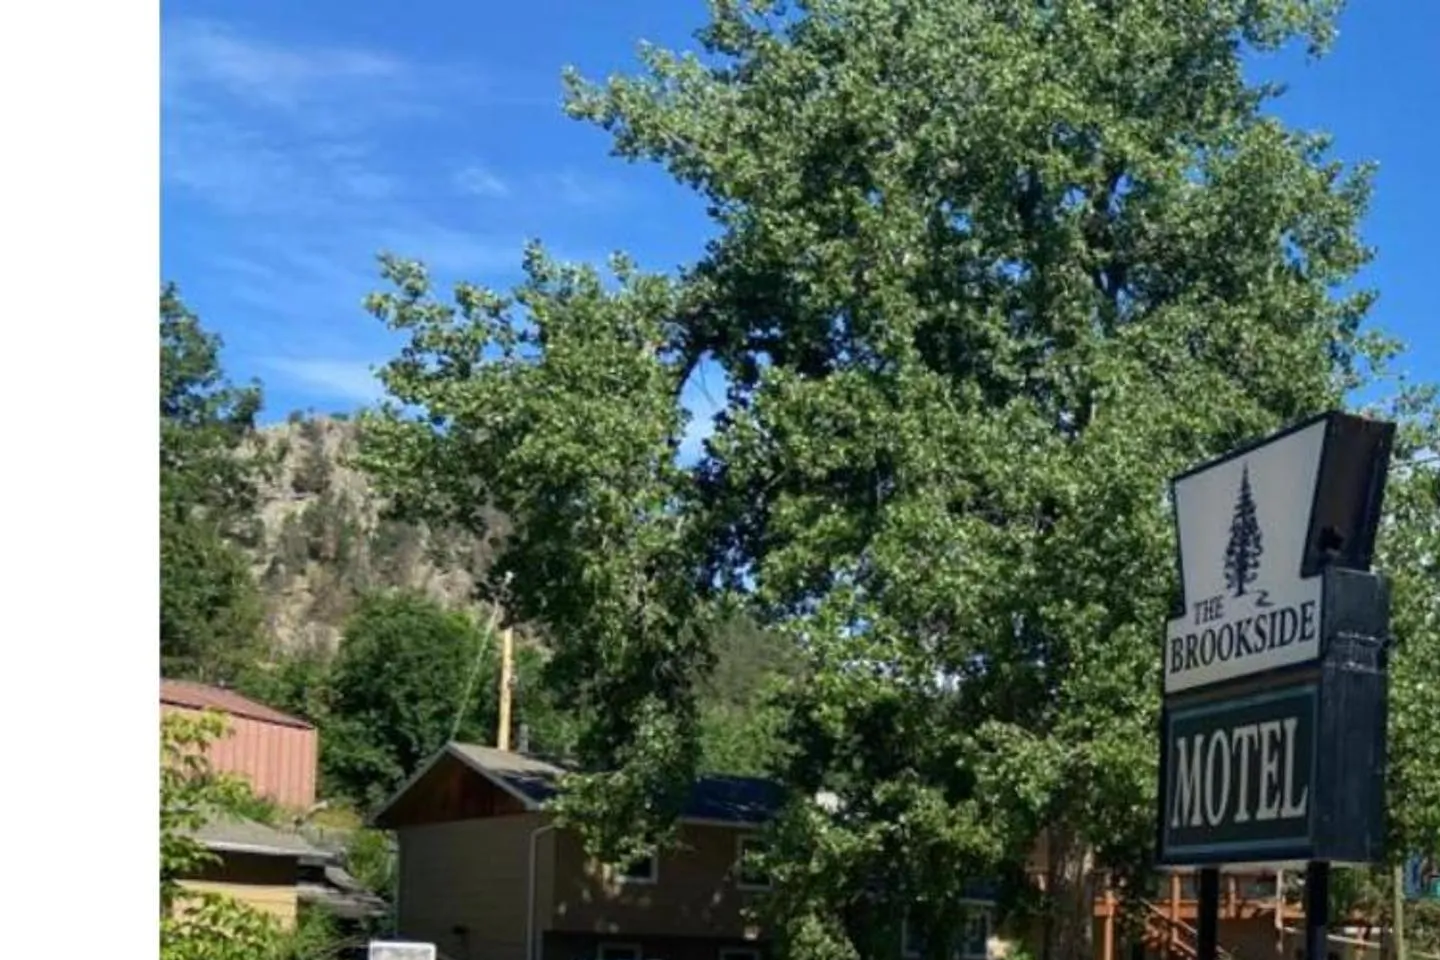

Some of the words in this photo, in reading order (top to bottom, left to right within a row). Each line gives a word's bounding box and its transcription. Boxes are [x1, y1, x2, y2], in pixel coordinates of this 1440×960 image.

[1169, 601, 1315, 674] BROOKSIDE
[1194, 596, 1225, 625] THE
[1172, 718, 1308, 829] MOTEL
